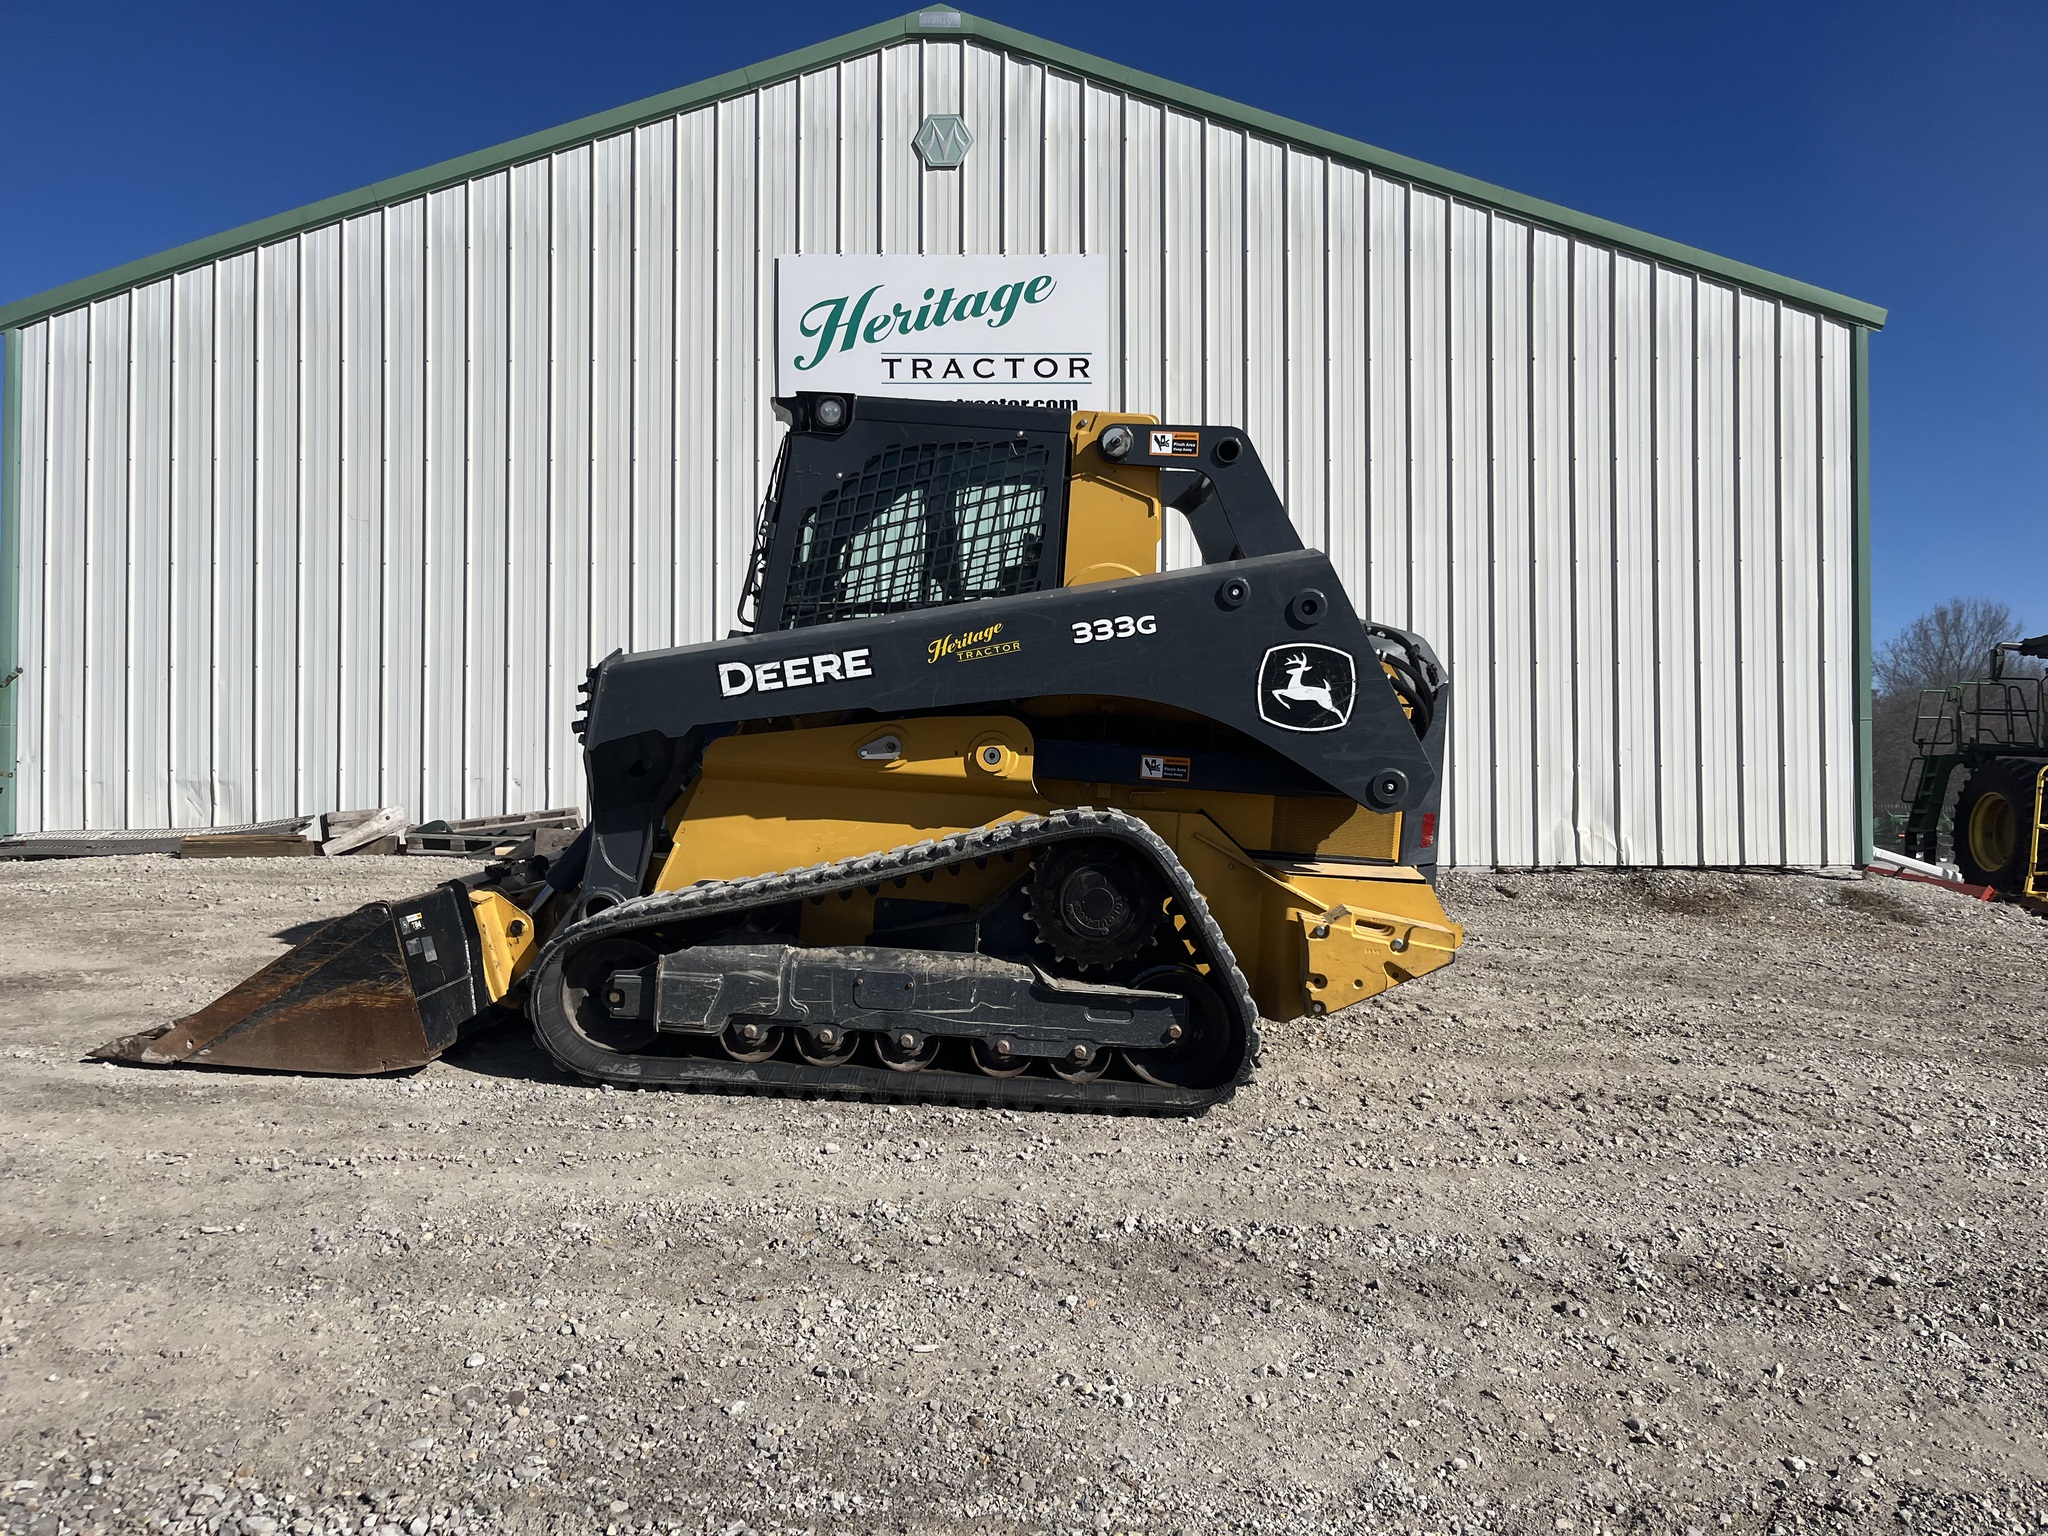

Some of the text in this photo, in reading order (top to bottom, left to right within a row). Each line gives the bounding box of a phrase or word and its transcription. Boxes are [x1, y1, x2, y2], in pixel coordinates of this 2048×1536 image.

[793, 274, 1058, 371] Heritage
[881, 357, 1090, 380] TRACTOR
[927, 621, 1004, 664] Heritage
[1071, 615, 1157, 645] 333G
[957, 641, 1021, 661] TRACTOR
[718, 648, 873, 698] DEERE
